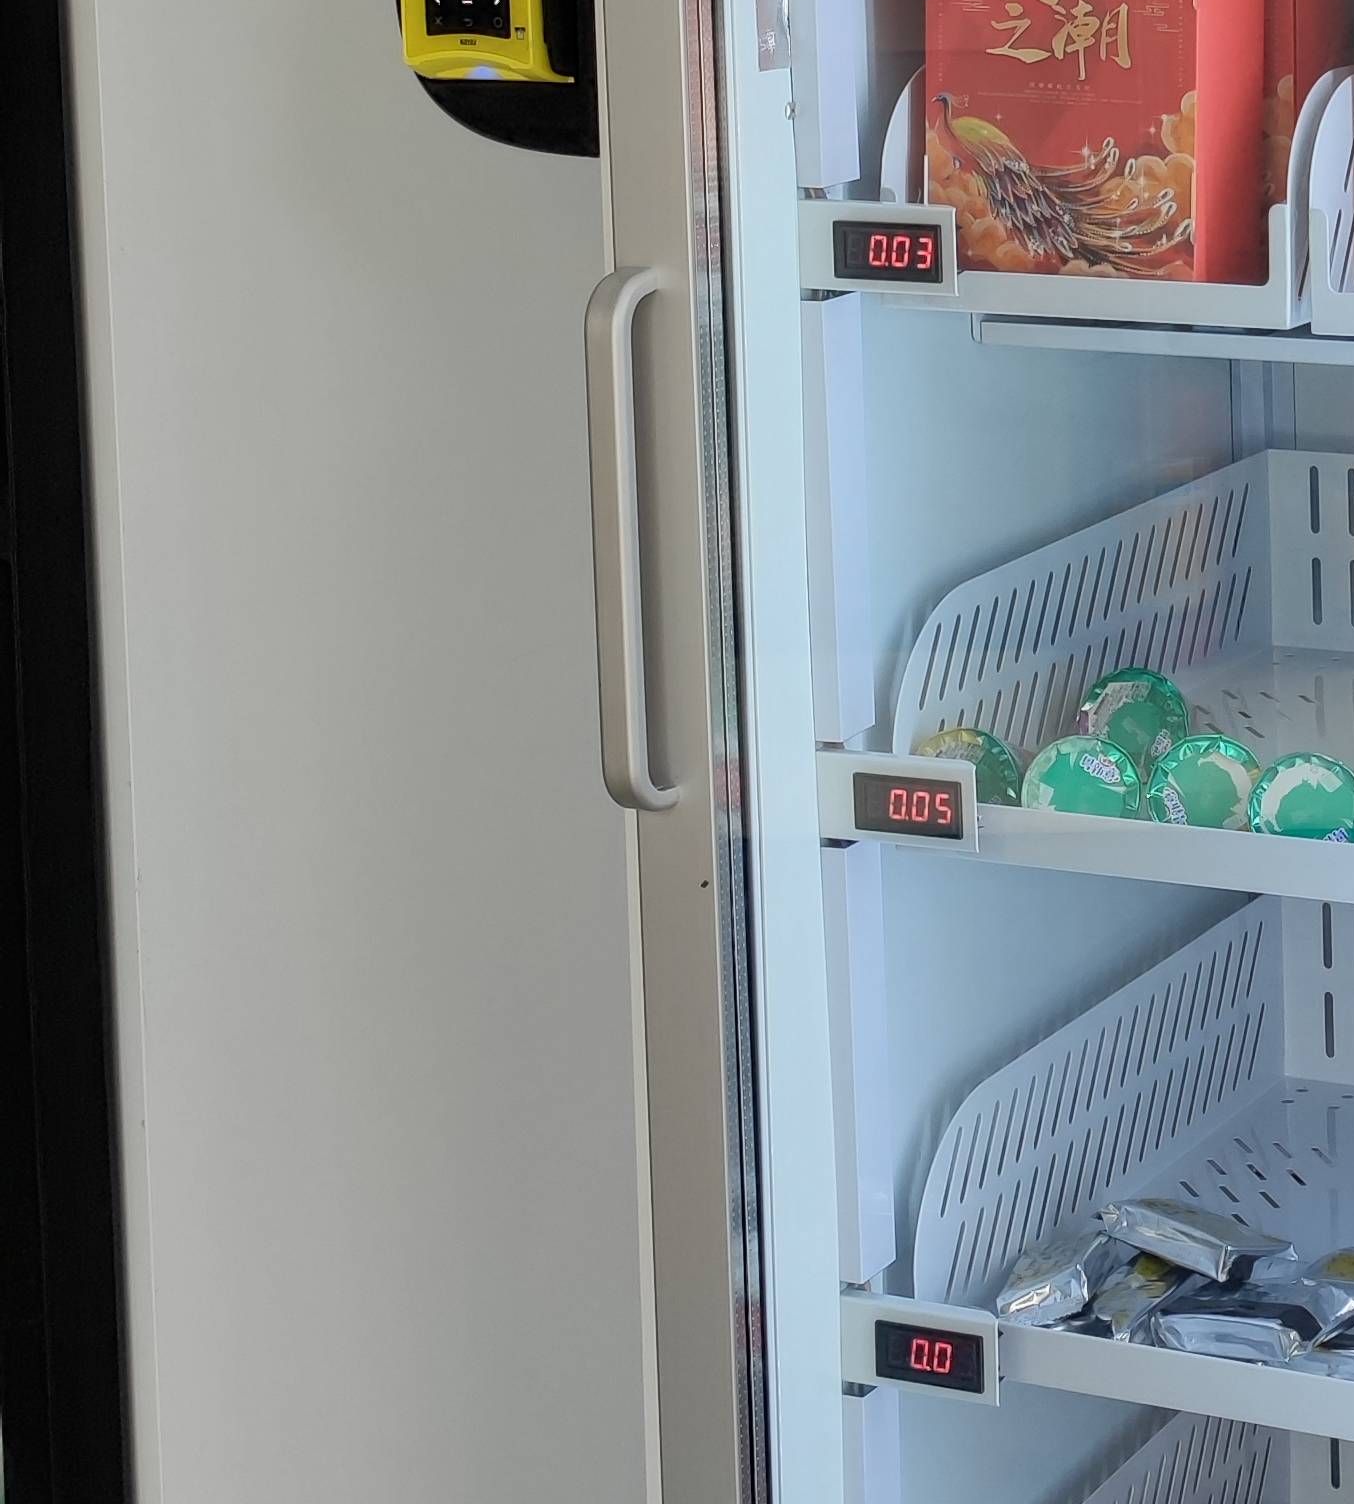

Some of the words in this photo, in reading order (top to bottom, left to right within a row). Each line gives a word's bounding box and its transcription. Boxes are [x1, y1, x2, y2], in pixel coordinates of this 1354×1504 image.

[985, 0, 1133, 81] 之潮
[869, 234, 933, 269] 0.03
[888, 788, 952, 824] 0.05
[910, 1337, 953, 1374] 0.0
